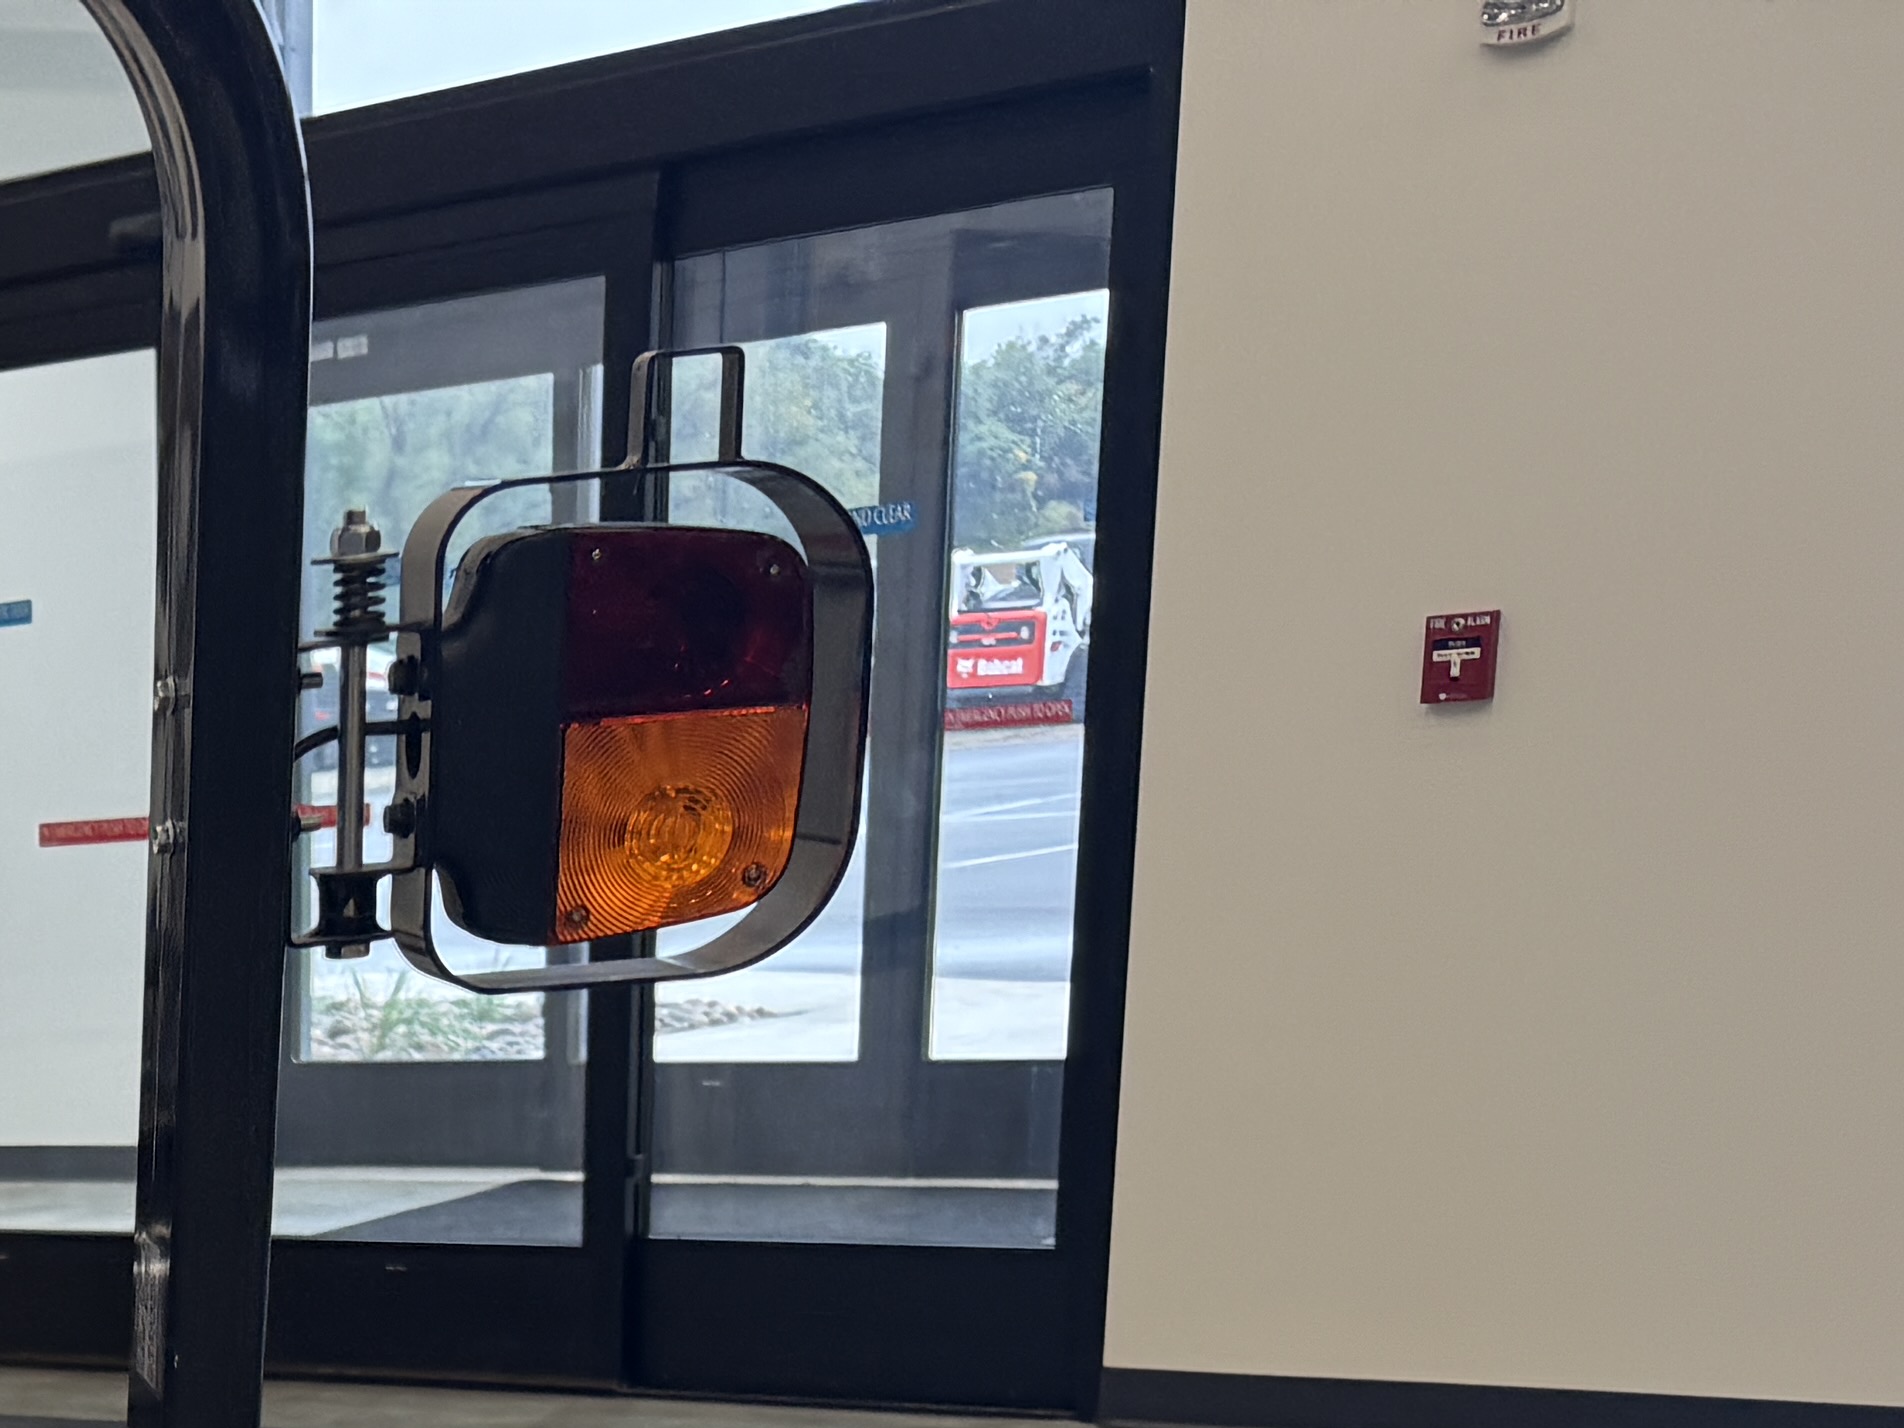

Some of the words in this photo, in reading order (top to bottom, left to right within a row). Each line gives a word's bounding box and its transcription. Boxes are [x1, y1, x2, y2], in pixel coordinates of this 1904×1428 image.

[1497, 23, 1541, 42] FIRE
[873, 501, 912, 525] CLEAR
[977, 657, 1023, 675] Bobcat
